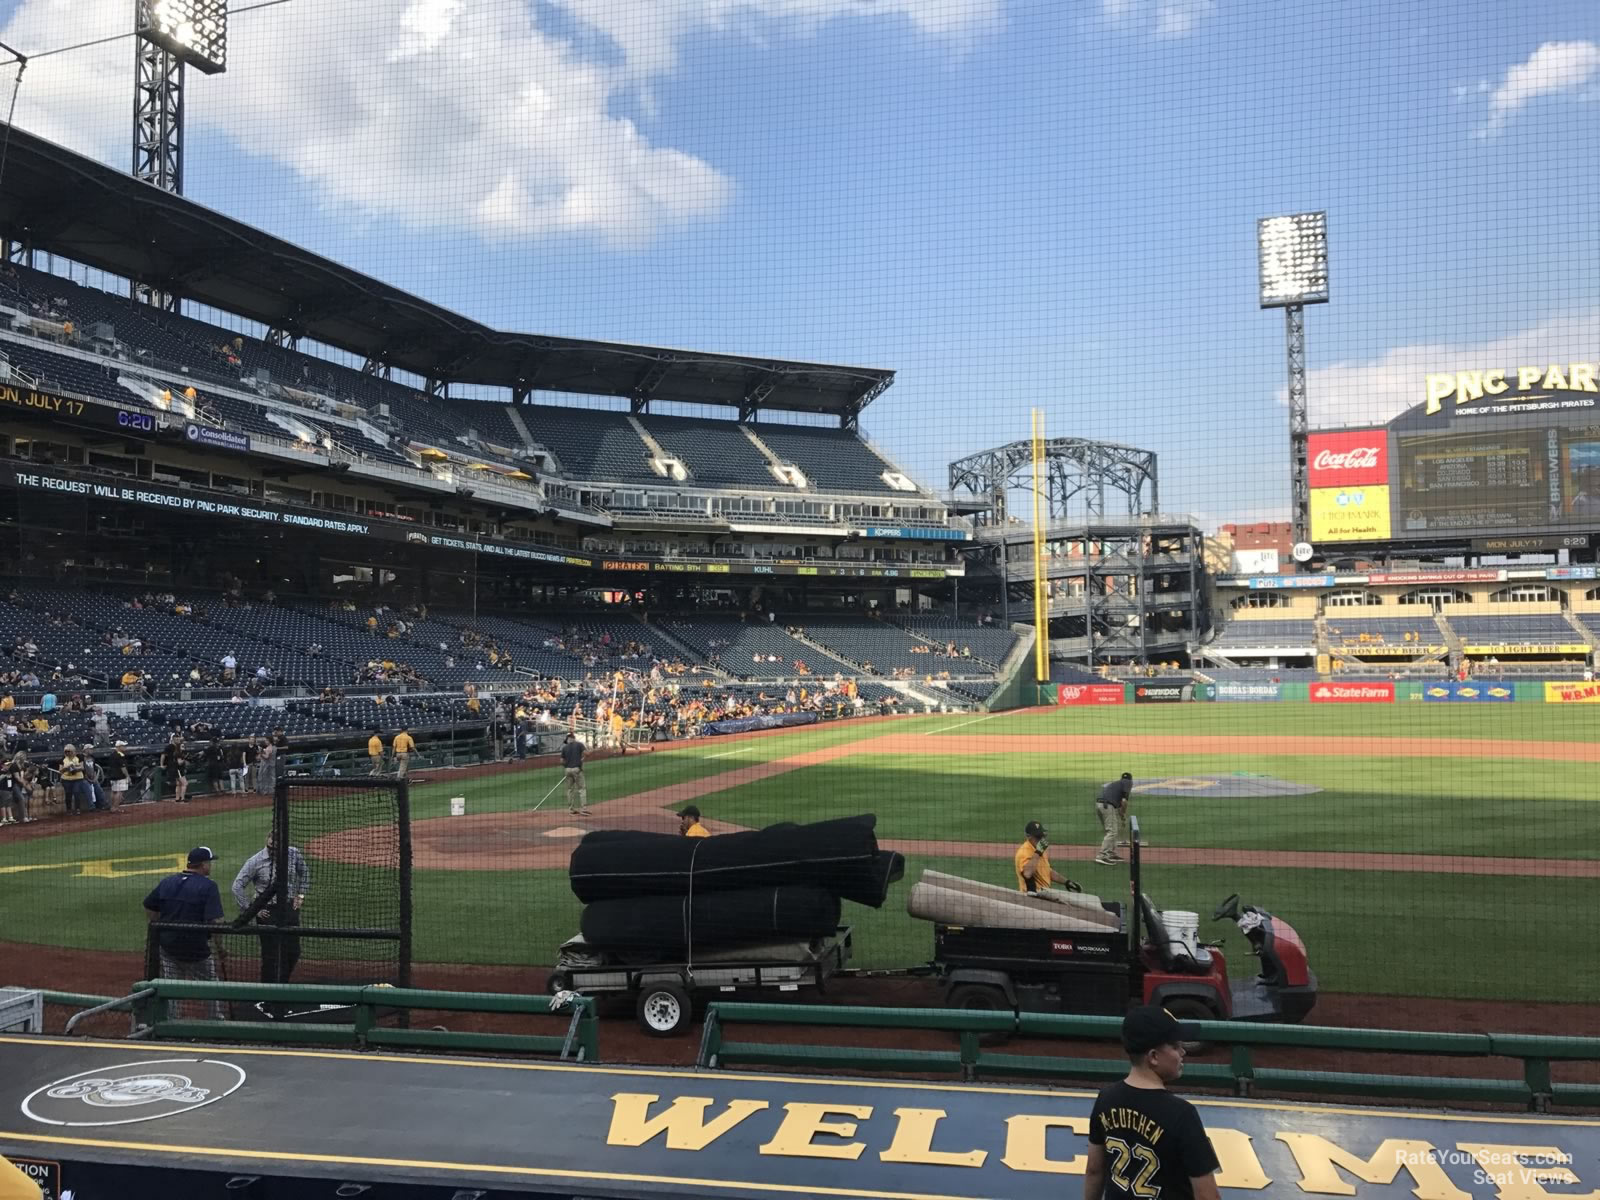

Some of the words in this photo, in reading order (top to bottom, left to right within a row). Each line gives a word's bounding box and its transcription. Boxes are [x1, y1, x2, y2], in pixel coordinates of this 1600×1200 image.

[1425, 368, 1510, 416] PNC
[25, 392, 63, 412] JULY
[66, 401, 84, 416] 17
[1455, 407, 1479, 416] HOME
[1479, 406, 1490, 414] OF
[1491, 405, 1508, 413] THE
[1509, 401, 1560, 412] PITTSBURGH
[1561, 399, 1595, 408] PIRATES
[118, 410, 152, 431] 6:20
[201, 428, 247, 445] Consolidated
[1548, 429, 1560, 502] BREWERS
[16, 473, 39, 487] THE
[41, 477, 92, 494] REQUEST
[93, 484, 120, 498] WILL
[121, 489, 135, 500] BE
[136, 491, 182, 507] RECEIVED
[182, 498, 196, 509] BY
[196, 500, 216, 512] PNC
[217, 504, 240, 515] PARK
[241, 507, 281, 522] SECURITY.
[283, 514, 324, 528] STANDARD
[324, 520, 346, 532] RATES
[346, 523, 370, 535] APPLY.
[1352, 526, 1377, 534] Health
[431, 536, 442, 544] GET
[483, 544, 495, 553] AND
[495, 546, 504, 554] ALL
[504, 547, 514, 555] THE
[1509, 540, 1530, 548] JULY
[1532, 539, 1543, 547] 17
[1563, 538, 1586, 546] 6:20
[654, 563, 684, 571] BATTING
[754, 566, 774, 574] KUHL
[1144, 688, 1181, 696] HANKOOK
[1219, 686, 1247, 695] BORDAS
[1249, 686, 1278, 695] BORDAS
[1053, 942, 1073, 950] TORO
[1077, 945, 1110, 953] WORKMAN
[1105, 1136, 1162, 1199] 22
